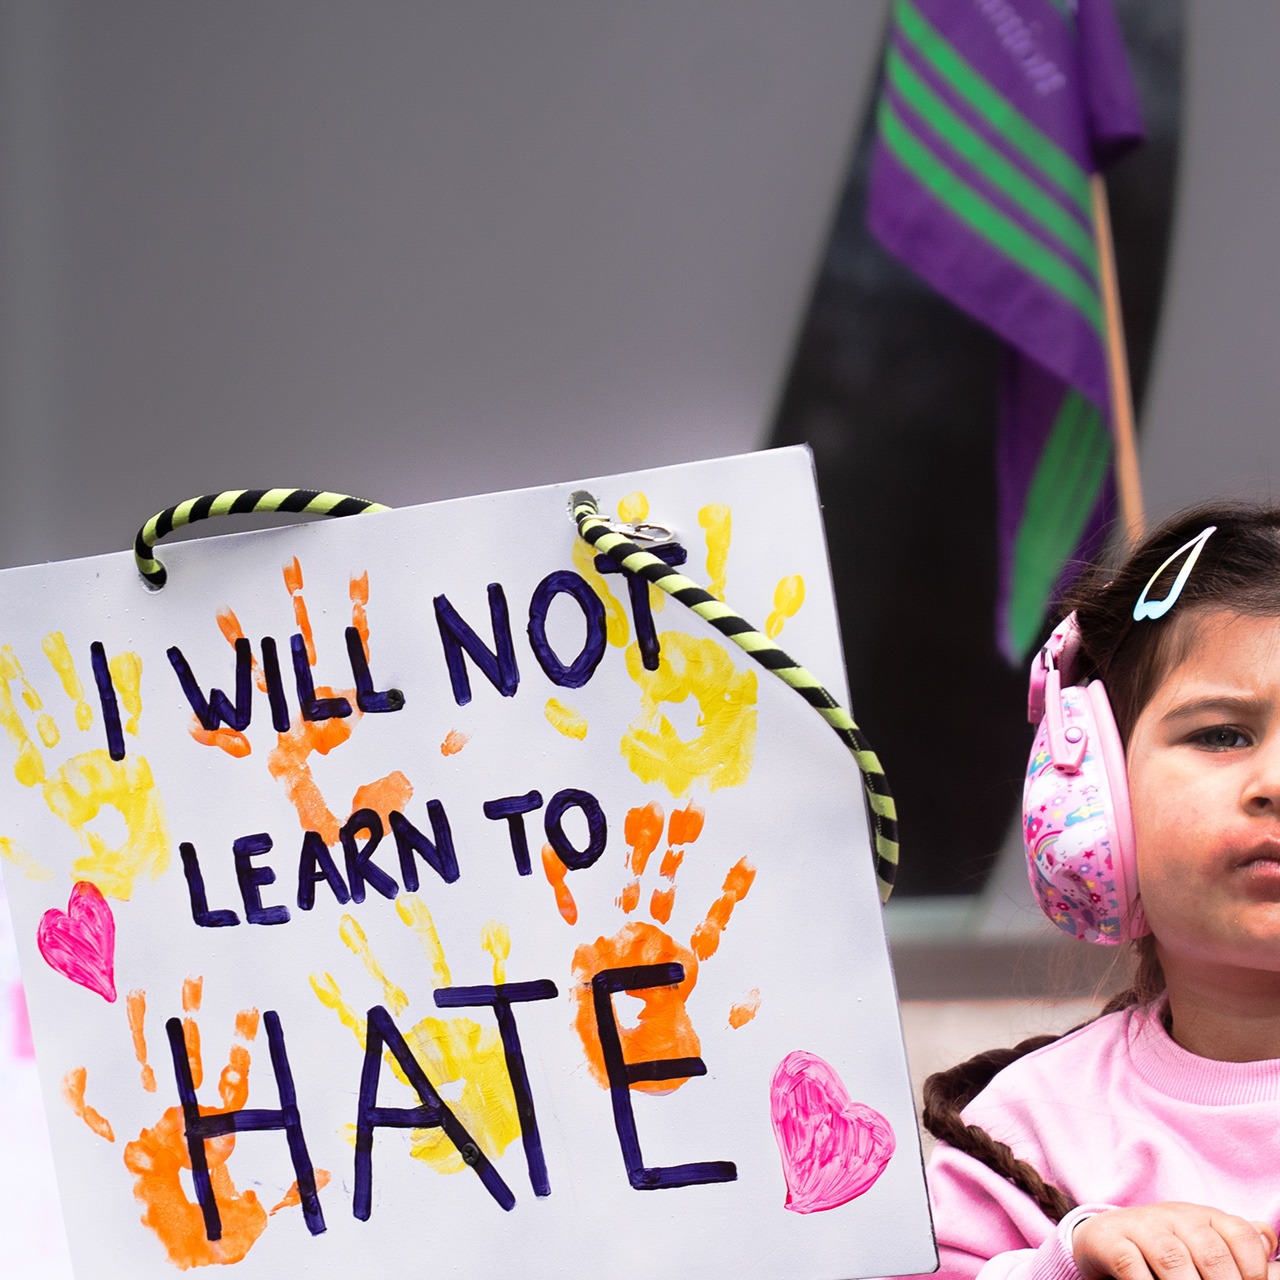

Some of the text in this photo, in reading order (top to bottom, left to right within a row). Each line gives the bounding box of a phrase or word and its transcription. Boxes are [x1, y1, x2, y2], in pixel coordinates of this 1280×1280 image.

[90, 543, 688, 761] I WILL NOT
[178, 788, 608, 928] LEARN TO
[165, 963, 738, 1242] HATE
